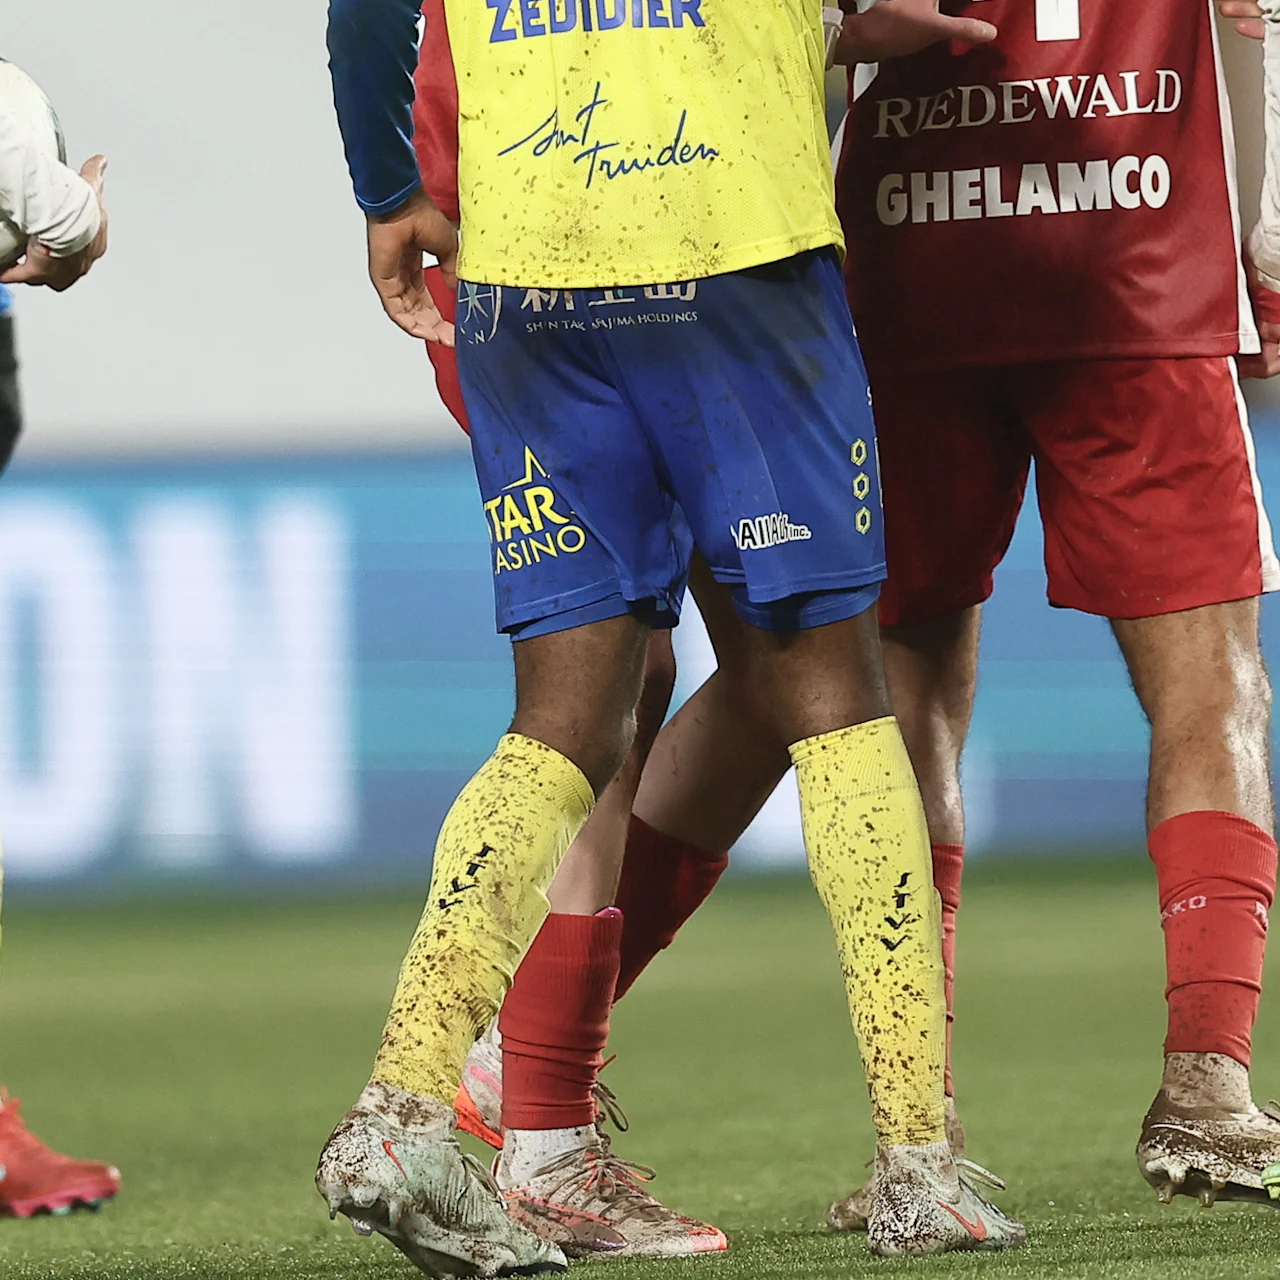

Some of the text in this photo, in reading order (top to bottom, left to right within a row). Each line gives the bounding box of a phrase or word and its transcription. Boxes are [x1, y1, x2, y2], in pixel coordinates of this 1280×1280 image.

[873, 69, 1182, 138] RIEDEWALD
[876, 154, 1171, 226] GHELAMCO
[637, 311, 699, 325] HOLDINGS
[483, 486, 571, 544] TAR
[493, 524, 586, 576] ASINO
[1160, 894, 1208, 921] AKO
